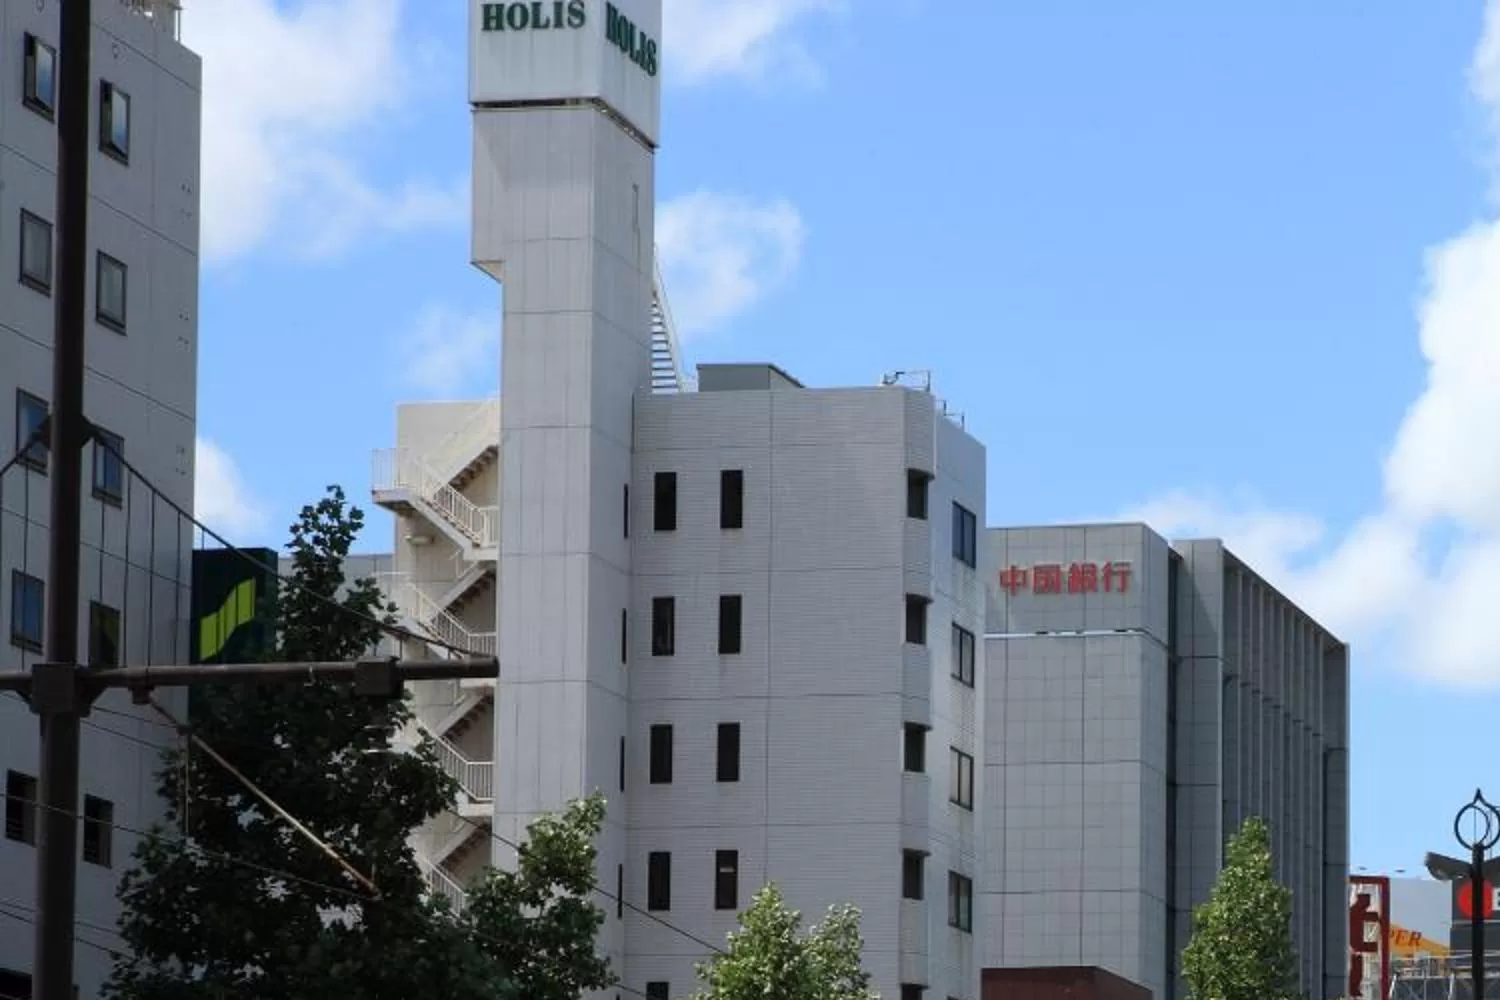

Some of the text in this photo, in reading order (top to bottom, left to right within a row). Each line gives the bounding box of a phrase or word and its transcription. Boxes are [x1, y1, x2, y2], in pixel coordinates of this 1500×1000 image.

[481, 1, 586, 31] HOLIS
[606, 2, 656, 76] HOLIS
[999, 562, 1133, 596] 中国銀行
